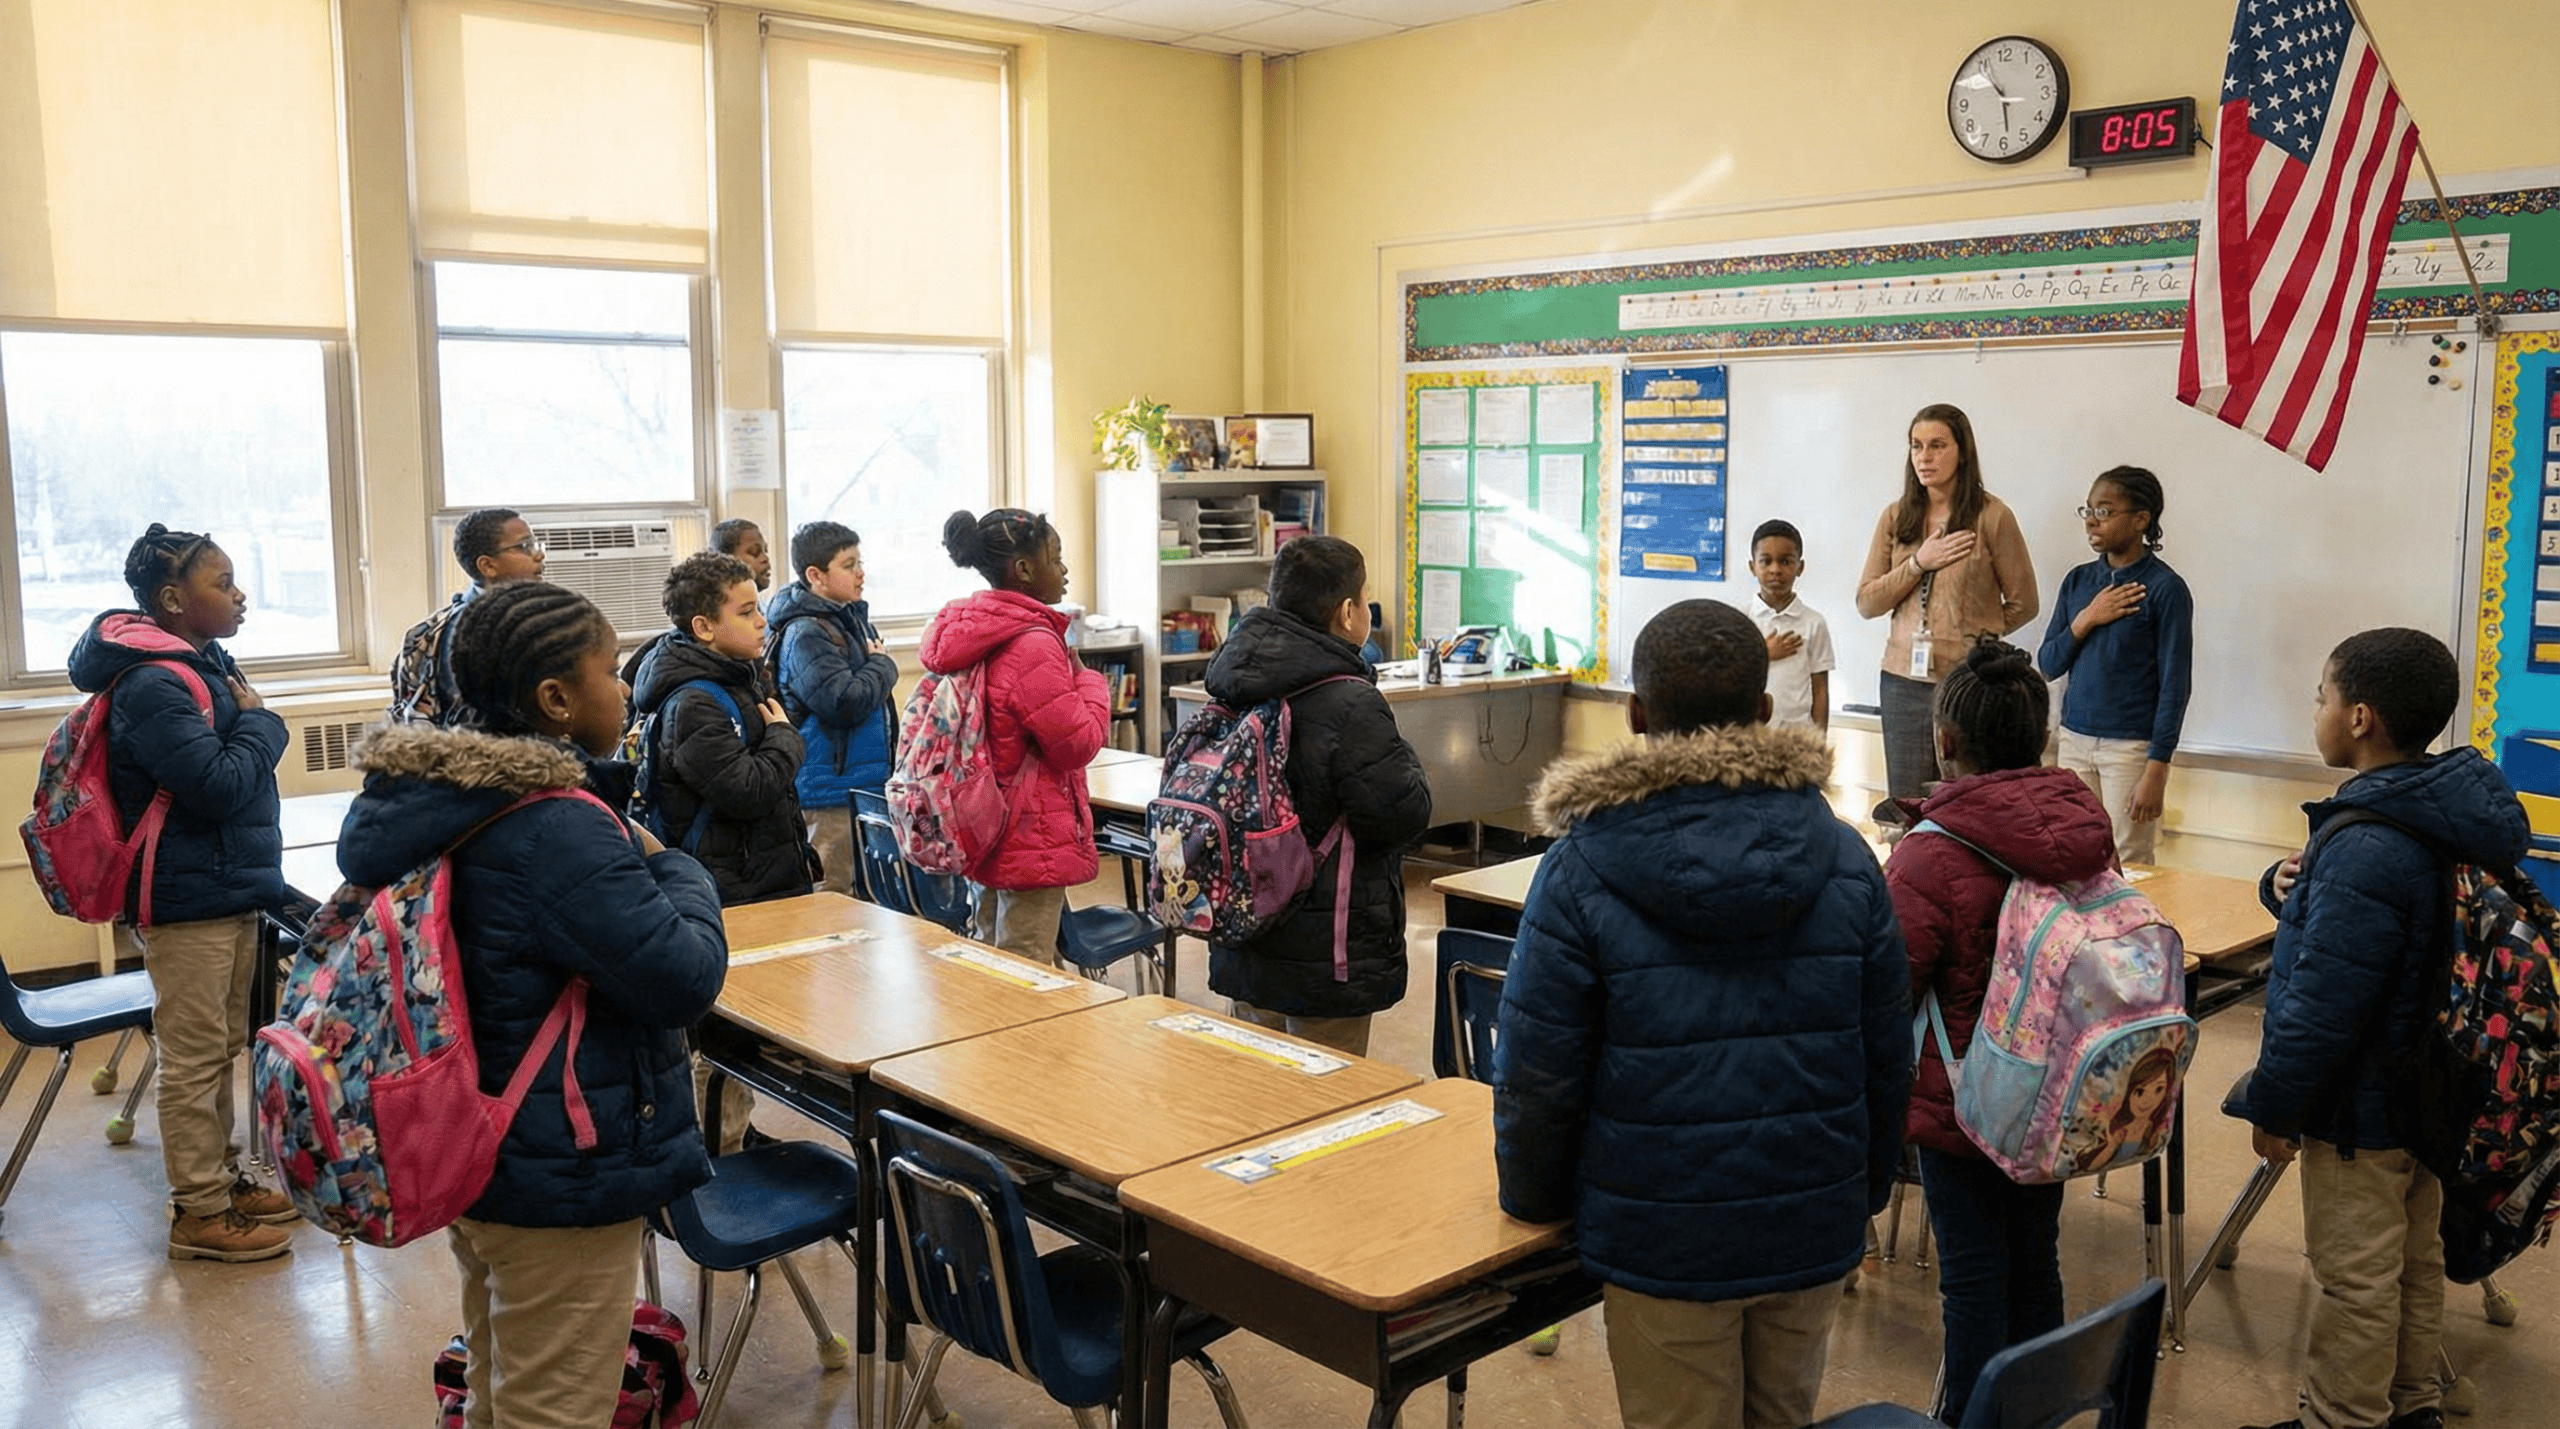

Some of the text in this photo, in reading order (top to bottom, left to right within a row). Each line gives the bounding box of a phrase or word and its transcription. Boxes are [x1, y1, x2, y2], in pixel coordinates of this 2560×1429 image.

[1998, 48, 2012, 62] 12
[2024, 51, 2029, 64] 1
[2035, 64, 2045, 79] 2
[2041, 85, 2050, 100] 3
[1959, 98, 1969, 113] 9
[2034, 110, 2043, 123] 4
[1966, 118, 1974, 133] 8
[2101, 109, 2177, 154] 8:05
[1981, 133, 1989, 147] 7
[2019, 128, 2028, 142] 5
[1999, 136, 2008, 151] 6
[1983, 284, 2003, 300] Nn
[2040, 280, 2060, 303] Pp
